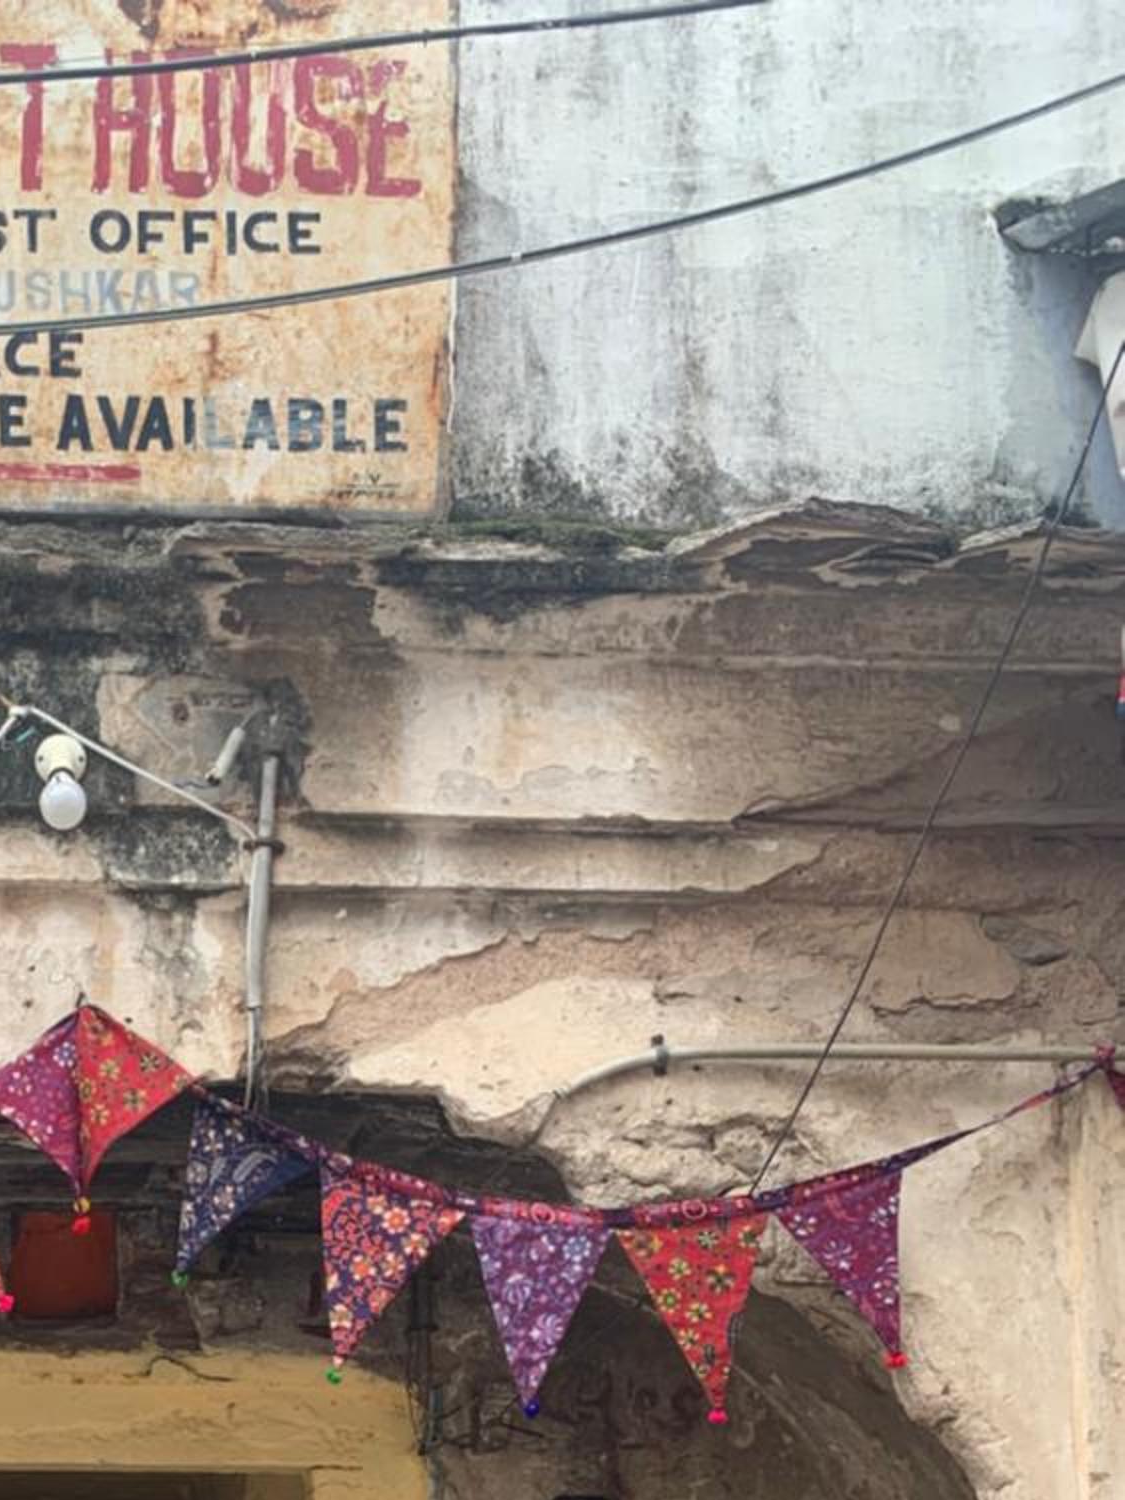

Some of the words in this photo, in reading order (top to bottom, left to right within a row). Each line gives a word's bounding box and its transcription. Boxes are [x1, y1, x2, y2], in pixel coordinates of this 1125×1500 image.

[92, 46, 423, 198] HOUSE
[89, 208, 322, 256] OFFICE
[56, 394, 409, 453] AVAILABLE
